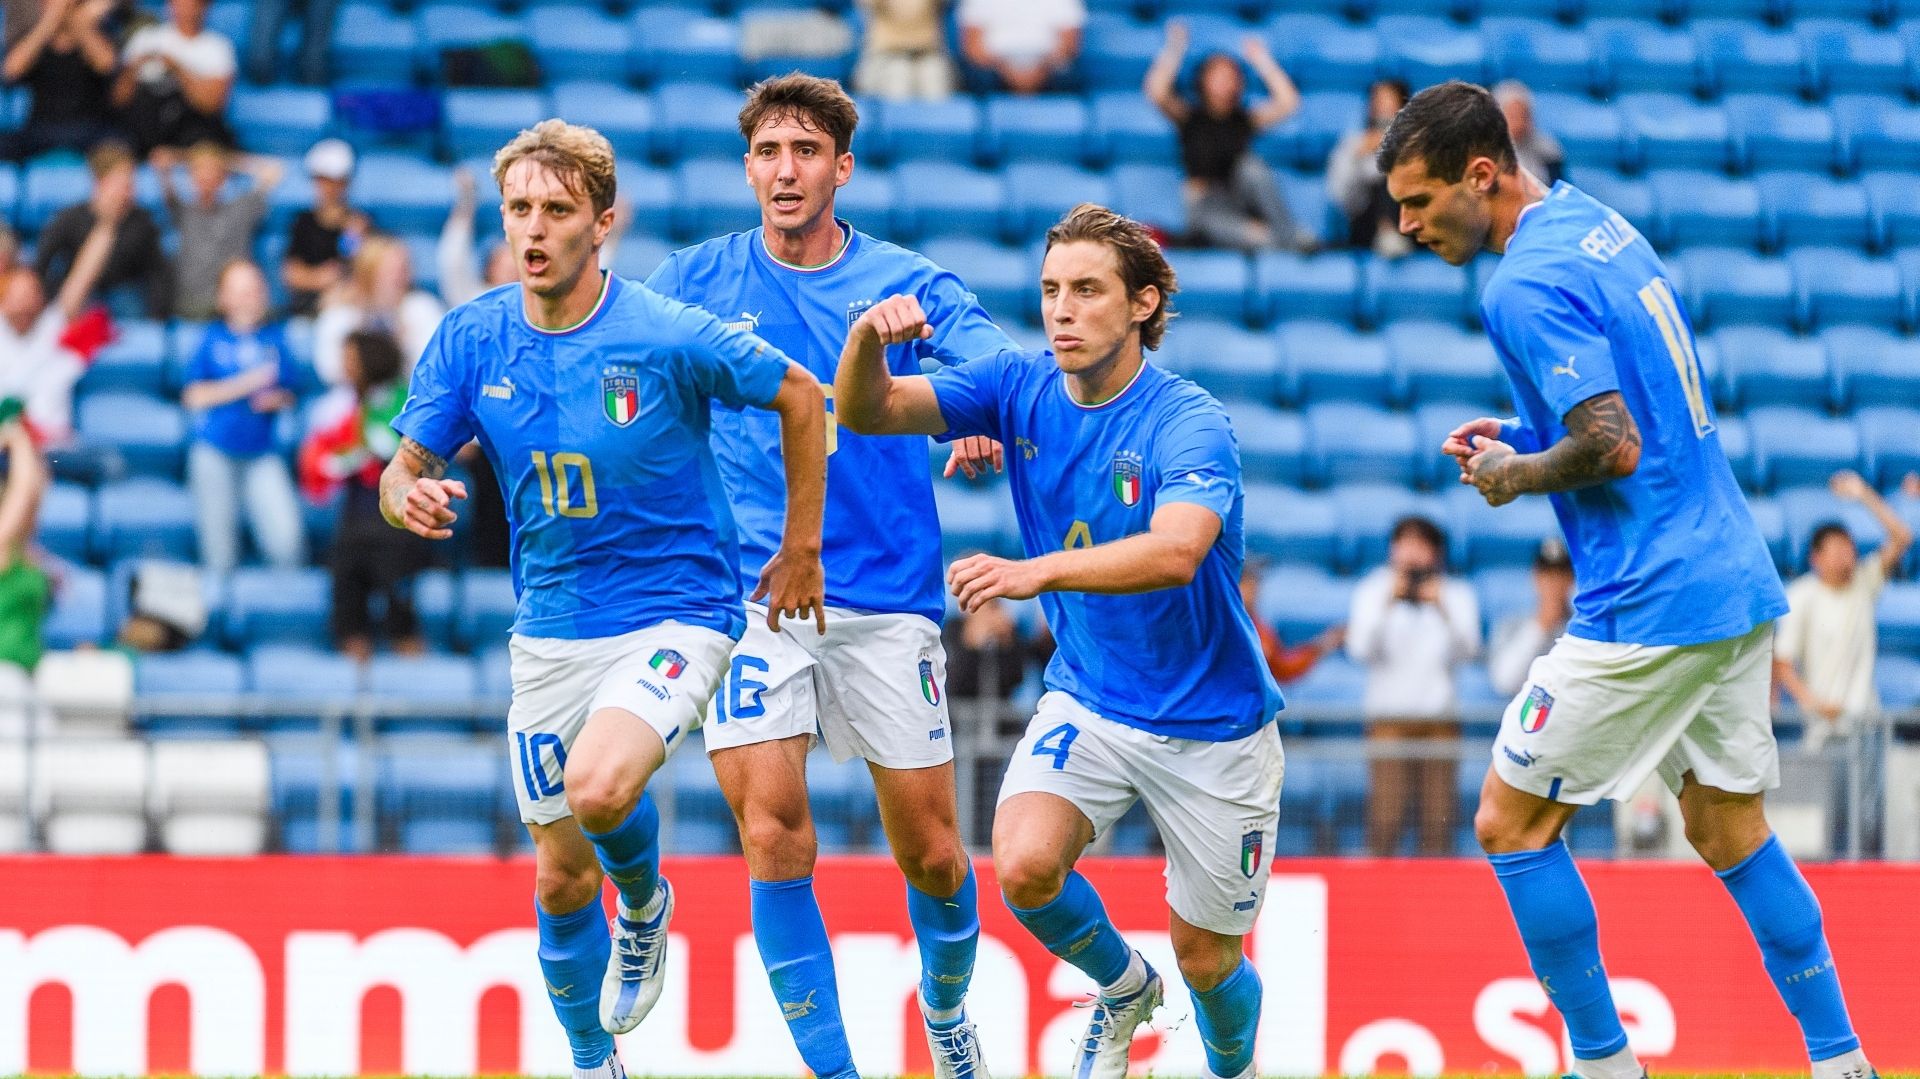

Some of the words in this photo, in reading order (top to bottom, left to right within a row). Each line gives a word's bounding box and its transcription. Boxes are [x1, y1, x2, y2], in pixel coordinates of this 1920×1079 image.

[482, 384, 511, 400] PUMA
[1637, 276, 1716, 440] 11
[531, 450, 599, 518] 10
[716, 654, 769, 724] 16
[516, 732, 568, 801] 10
[1031, 722, 1080, 770] 4
